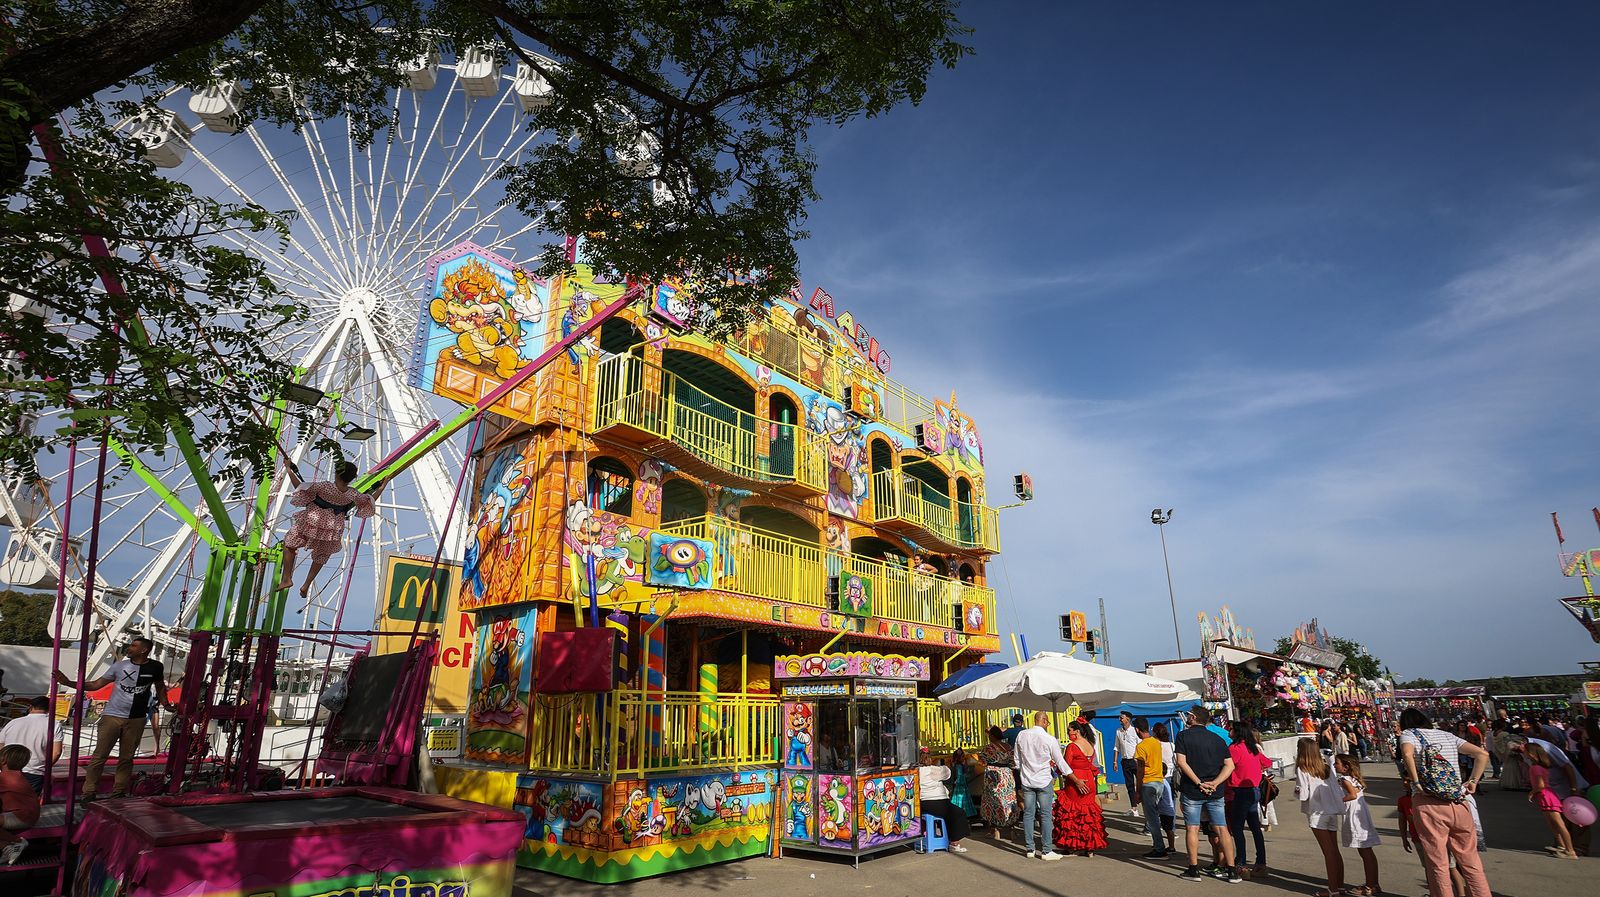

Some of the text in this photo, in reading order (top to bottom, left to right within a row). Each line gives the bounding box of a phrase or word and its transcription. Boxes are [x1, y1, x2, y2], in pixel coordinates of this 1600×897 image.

[809, 287, 891, 374] MARIO
[877, 621, 925, 640] MARIO
[785, 683, 847, 695] TAQUILLA
